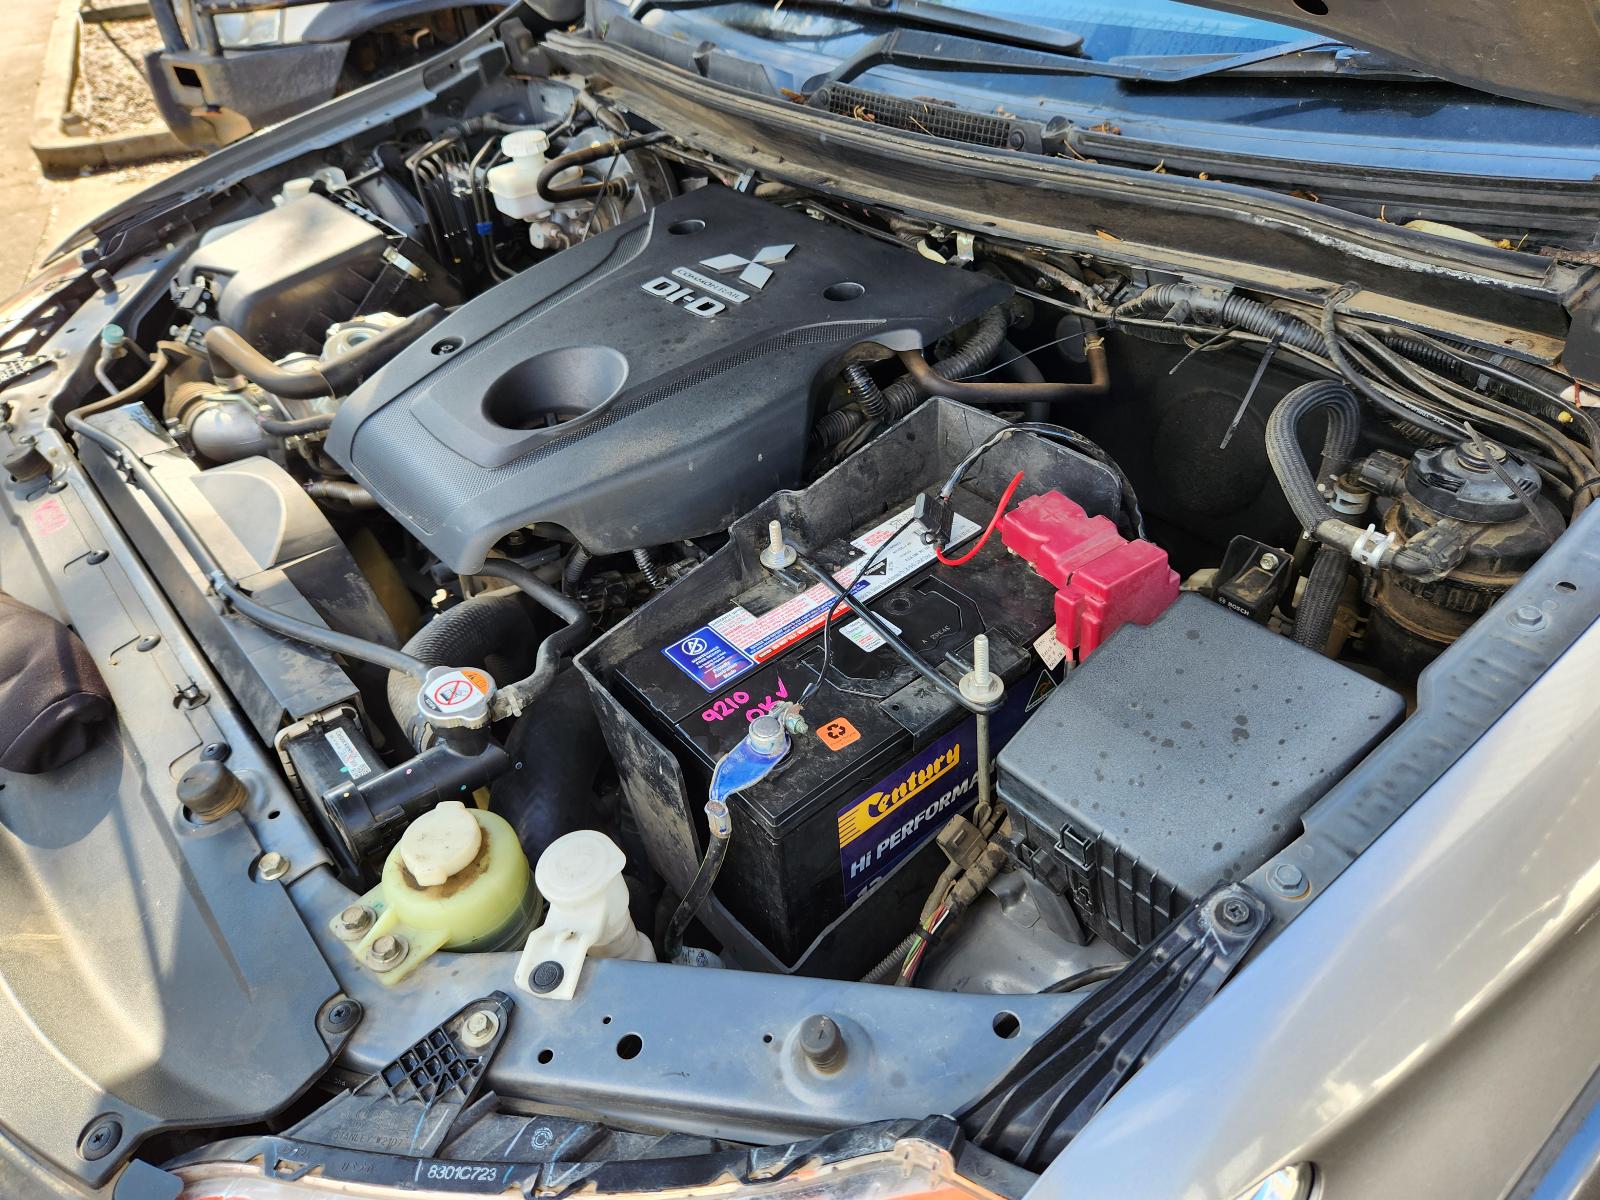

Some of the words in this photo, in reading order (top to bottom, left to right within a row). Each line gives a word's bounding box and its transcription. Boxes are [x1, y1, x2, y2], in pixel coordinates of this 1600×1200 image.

[676, 268, 719, 290] COMMON
[719, 286, 742, 300] RAIL
[1226, 601, 1250, 616] BOSCH
[701, 691, 750, 721] 9210
[864, 743, 960, 818] Century
[850, 850, 873, 879] Hi
[876, 769, 981, 860] PERFORMA
[427, 1165, 497, 1182] 8301C723
